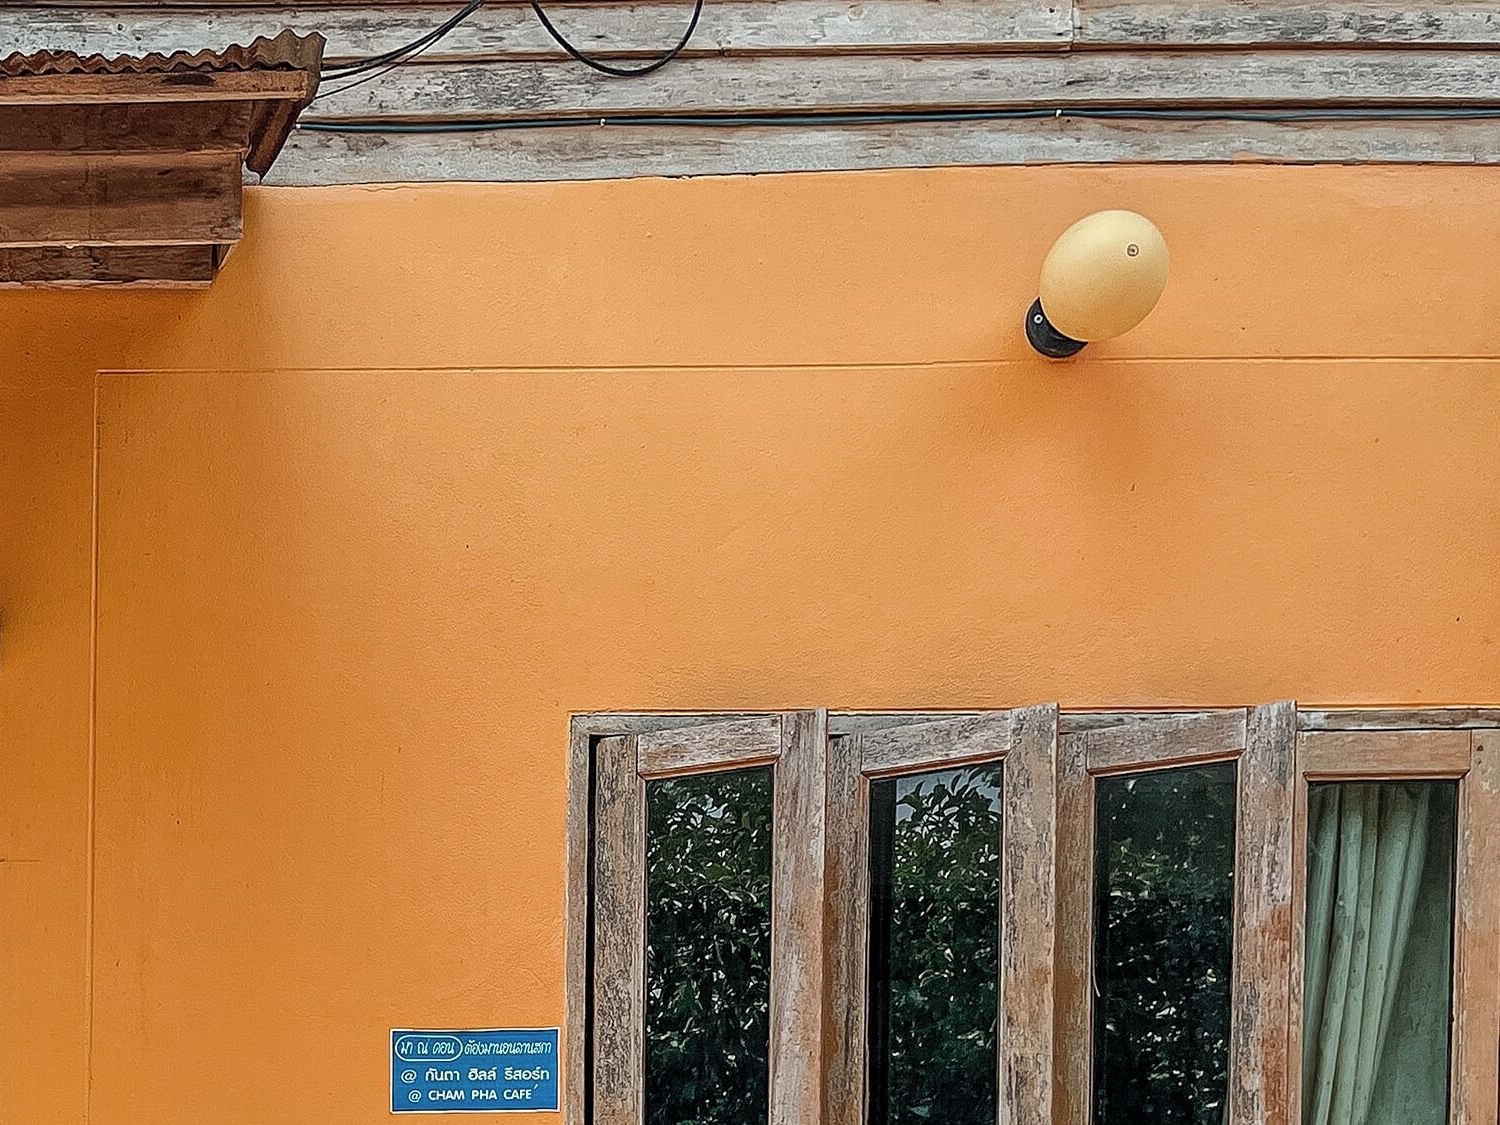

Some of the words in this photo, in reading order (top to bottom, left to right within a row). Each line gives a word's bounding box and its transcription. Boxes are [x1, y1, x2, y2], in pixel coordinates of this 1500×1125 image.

[401, 1069, 417, 1083] @
[425, 1067, 460, 1082] กันตา
[467, 1066, 498, 1081] ฮิลล์
[504, 1066, 550, 1081] รีสอร์ท
[408, 1090, 422, 1103] @
[428, 1089, 465, 1101] CHAM
[471, 1089, 497, 1100] PHA
